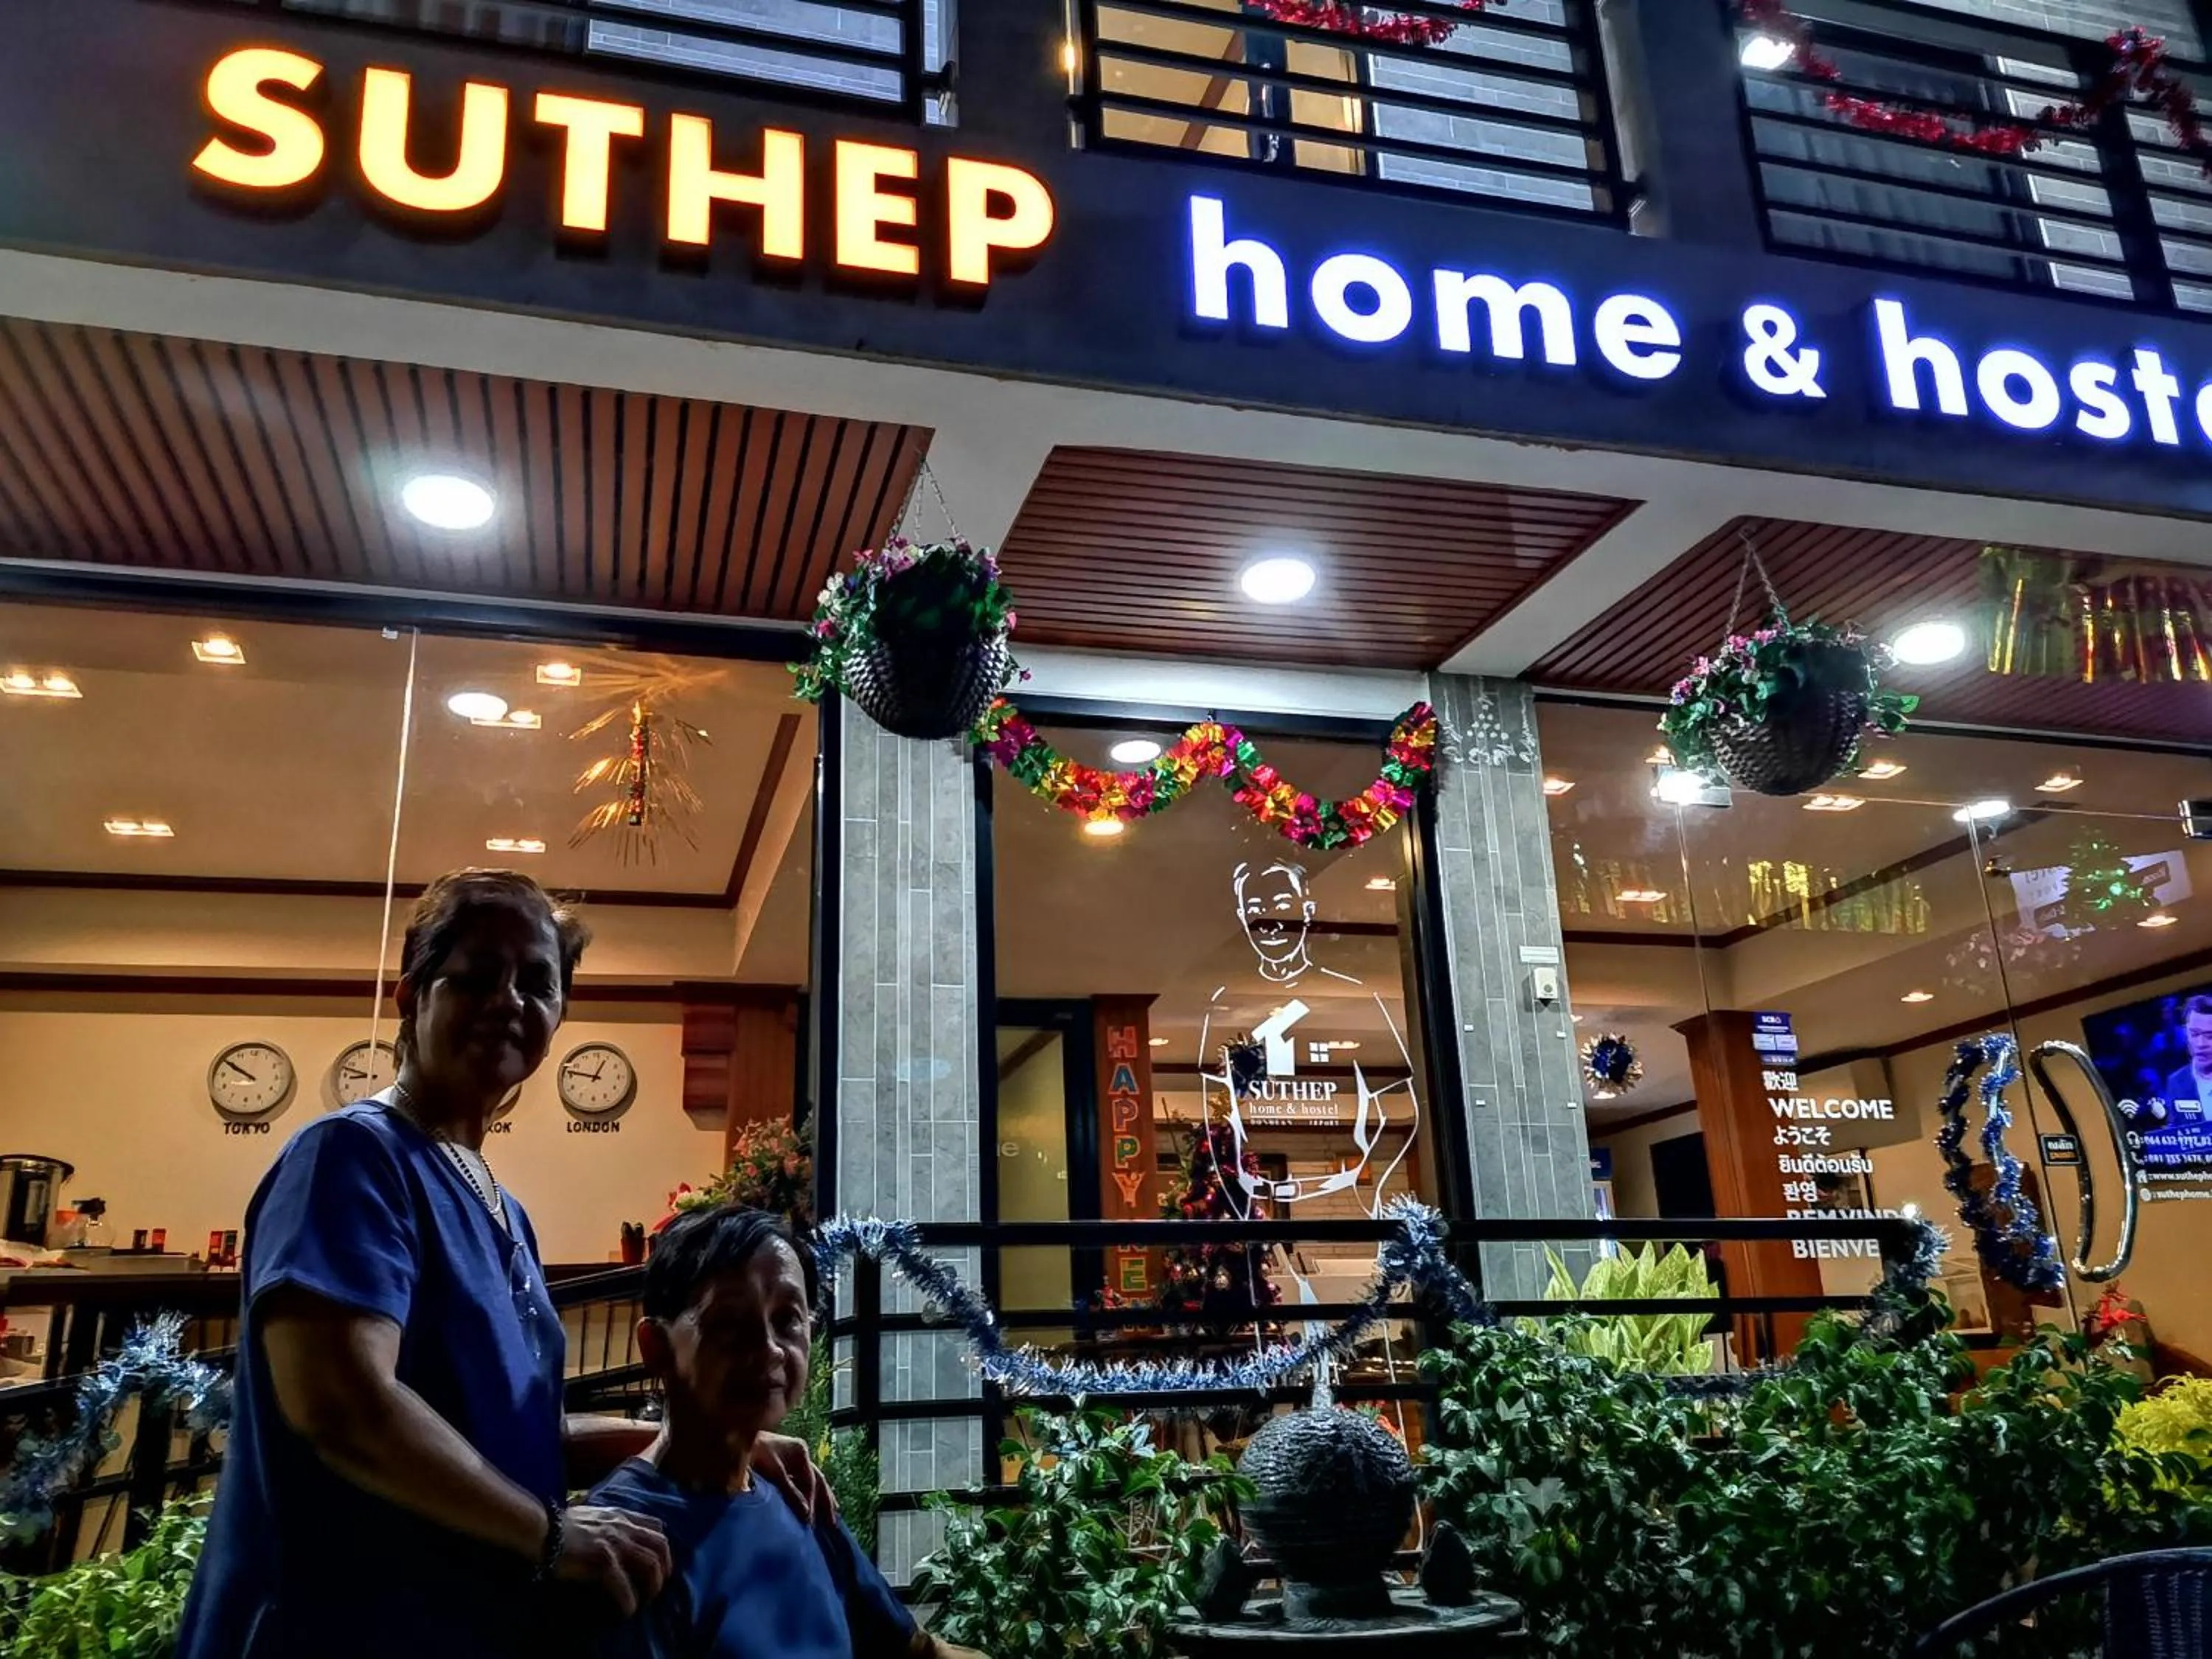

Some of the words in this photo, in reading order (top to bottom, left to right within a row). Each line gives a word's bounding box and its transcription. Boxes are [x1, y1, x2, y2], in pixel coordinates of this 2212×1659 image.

[192, 48, 1054, 285] SUTHEP
[1189, 195, 1682, 380] home
[1742, 304, 1828, 398] &
[1874, 298, 2212, 445] host
[1248, 1079, 1338, 1101] SUTHEP
[1107, 1026, 1146, 1208] HAPPY
[1249, 1102, 1283, 1114] home
[1287, 1102, 1296, 1115] &
[1301, 1102, 1339, 1116] hostel
[1767, 1098, 1894, 1120] WELCOME
[223, 1121, 271, 1135] TOKYO
[566, 1121, 620, 1133] LONDON
[1773, 1124, 1832, 1146] ようこそ
[1778, 1153, 1874, 1174] ยินดีต้อนรับ
[1783, 1181, 1818, 1203] 환영
[1792, 1239, 1881, 1259] BIENVE
